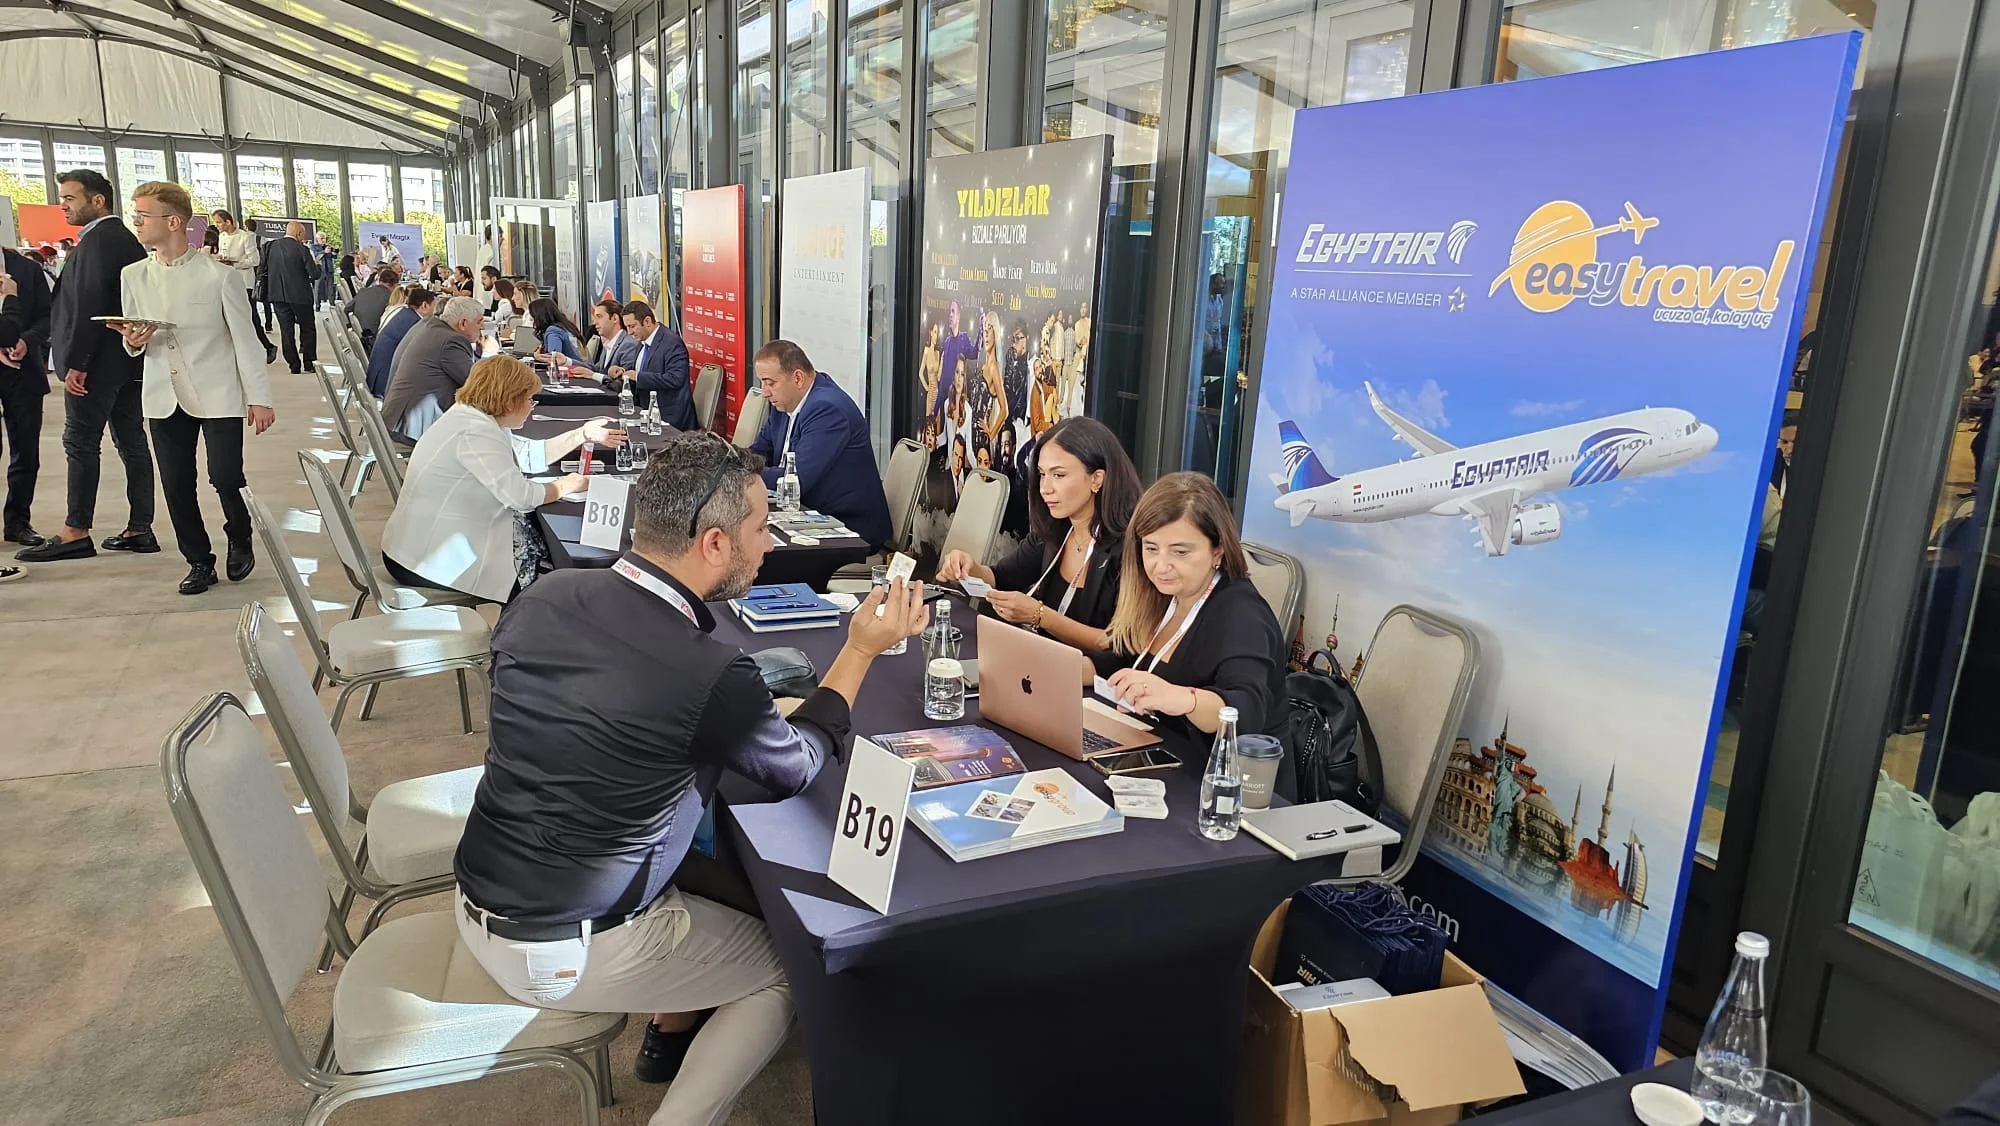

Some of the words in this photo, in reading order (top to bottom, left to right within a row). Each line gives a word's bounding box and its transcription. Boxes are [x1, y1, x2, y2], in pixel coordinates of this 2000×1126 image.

[957, 184, 1050, 218] YILDIZLAR
[371, 232, 410, 241] EvtMagix
[1296, 223, 1444, 265] EGYPTAIR
[1524, 240, 1795, 312] easytravel
[1291, 288, 1297, 298] A
[1300, 288, 1326, 300] STAR
[1328, 289, 1384, 303] ALLIANCE
[1386, 292, 1441, 307] MEMBER
[1654, 309, 1692, 322] ucuza
[1711, 310, 1751, 328] kolay
[1752, 312, 1772, 328] uç
[1450, 450, 1550, 488] EGYPTAIR
[588, 501, 620, 527] B18
[843, 792, 894, 857] B19
